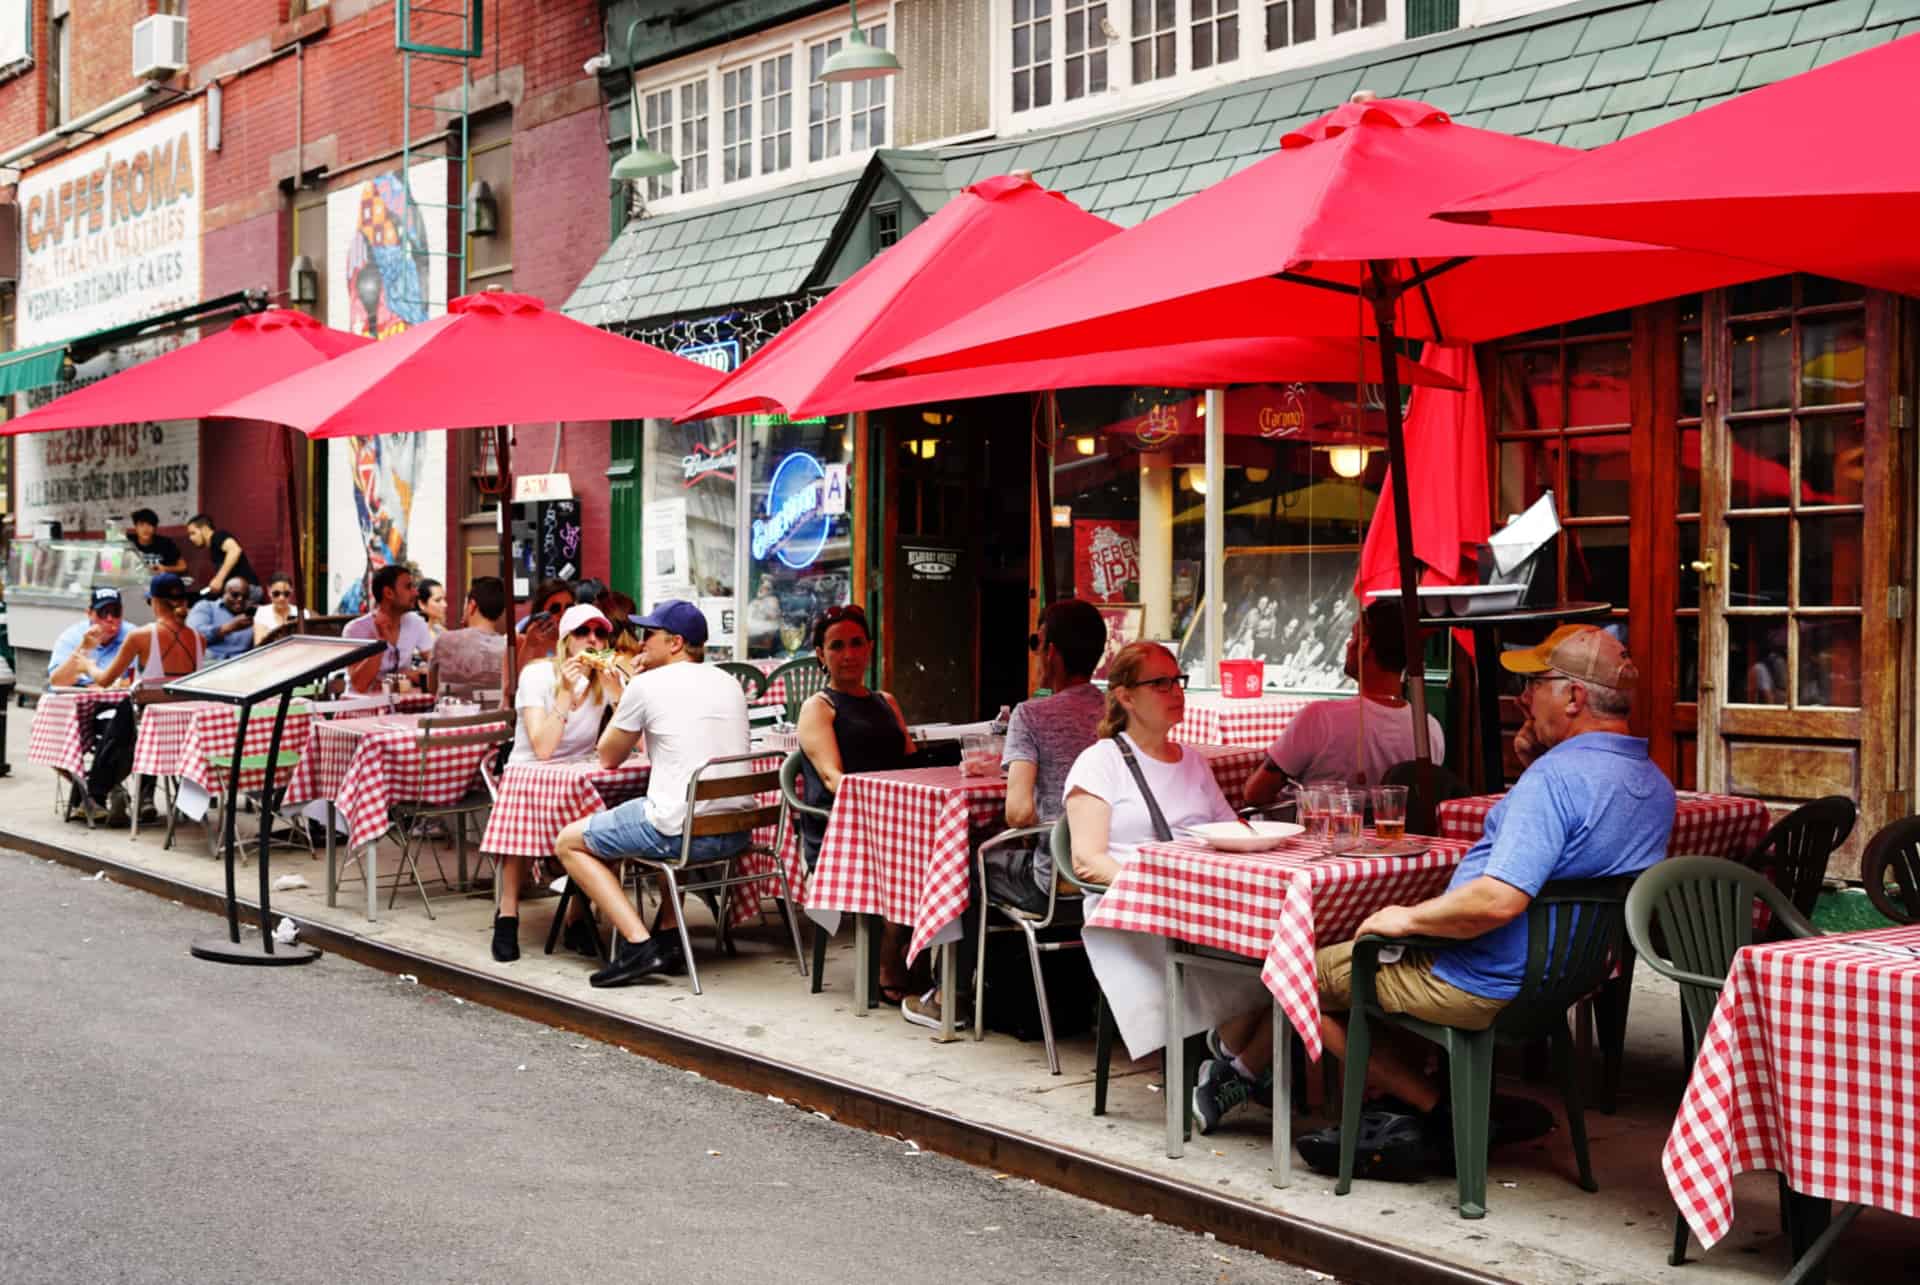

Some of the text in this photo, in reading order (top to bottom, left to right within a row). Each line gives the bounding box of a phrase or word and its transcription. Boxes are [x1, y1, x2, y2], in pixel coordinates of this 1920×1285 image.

[111, 130, 194, 228] ROMA
[127, 463, 190, 498] PREMISES
[828, 471, 842, 500] A
[1090, 537, 1140, 573] REBEL
[1103, 558, 1140, 592] IPA
